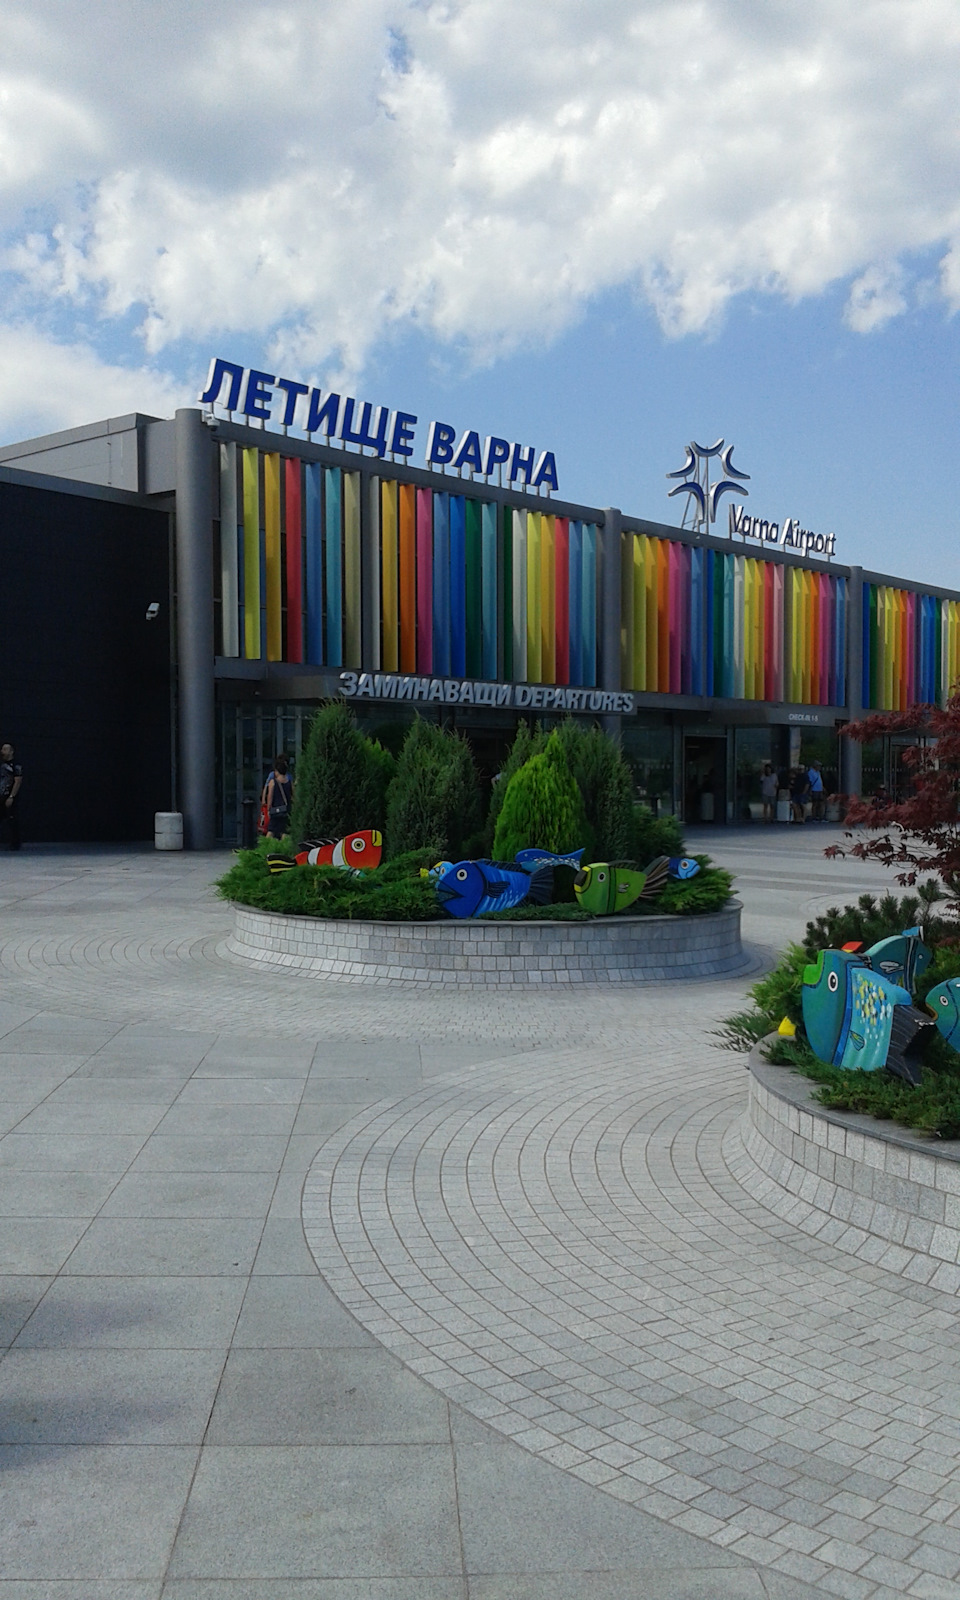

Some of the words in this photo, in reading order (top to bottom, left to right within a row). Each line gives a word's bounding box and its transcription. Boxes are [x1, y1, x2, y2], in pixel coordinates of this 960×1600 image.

[198, 357, 418, 458] ЛЕТИЩЕ
[426, 421, 559, 491] ВАРНА
[729, 503, 780, 543] Varna
[780, 518, 837, 558] Airport
[338, 671, 512, 707] ЗАМИНАВАЩИ
[515, 684, 635, 713] DEPARTURES
